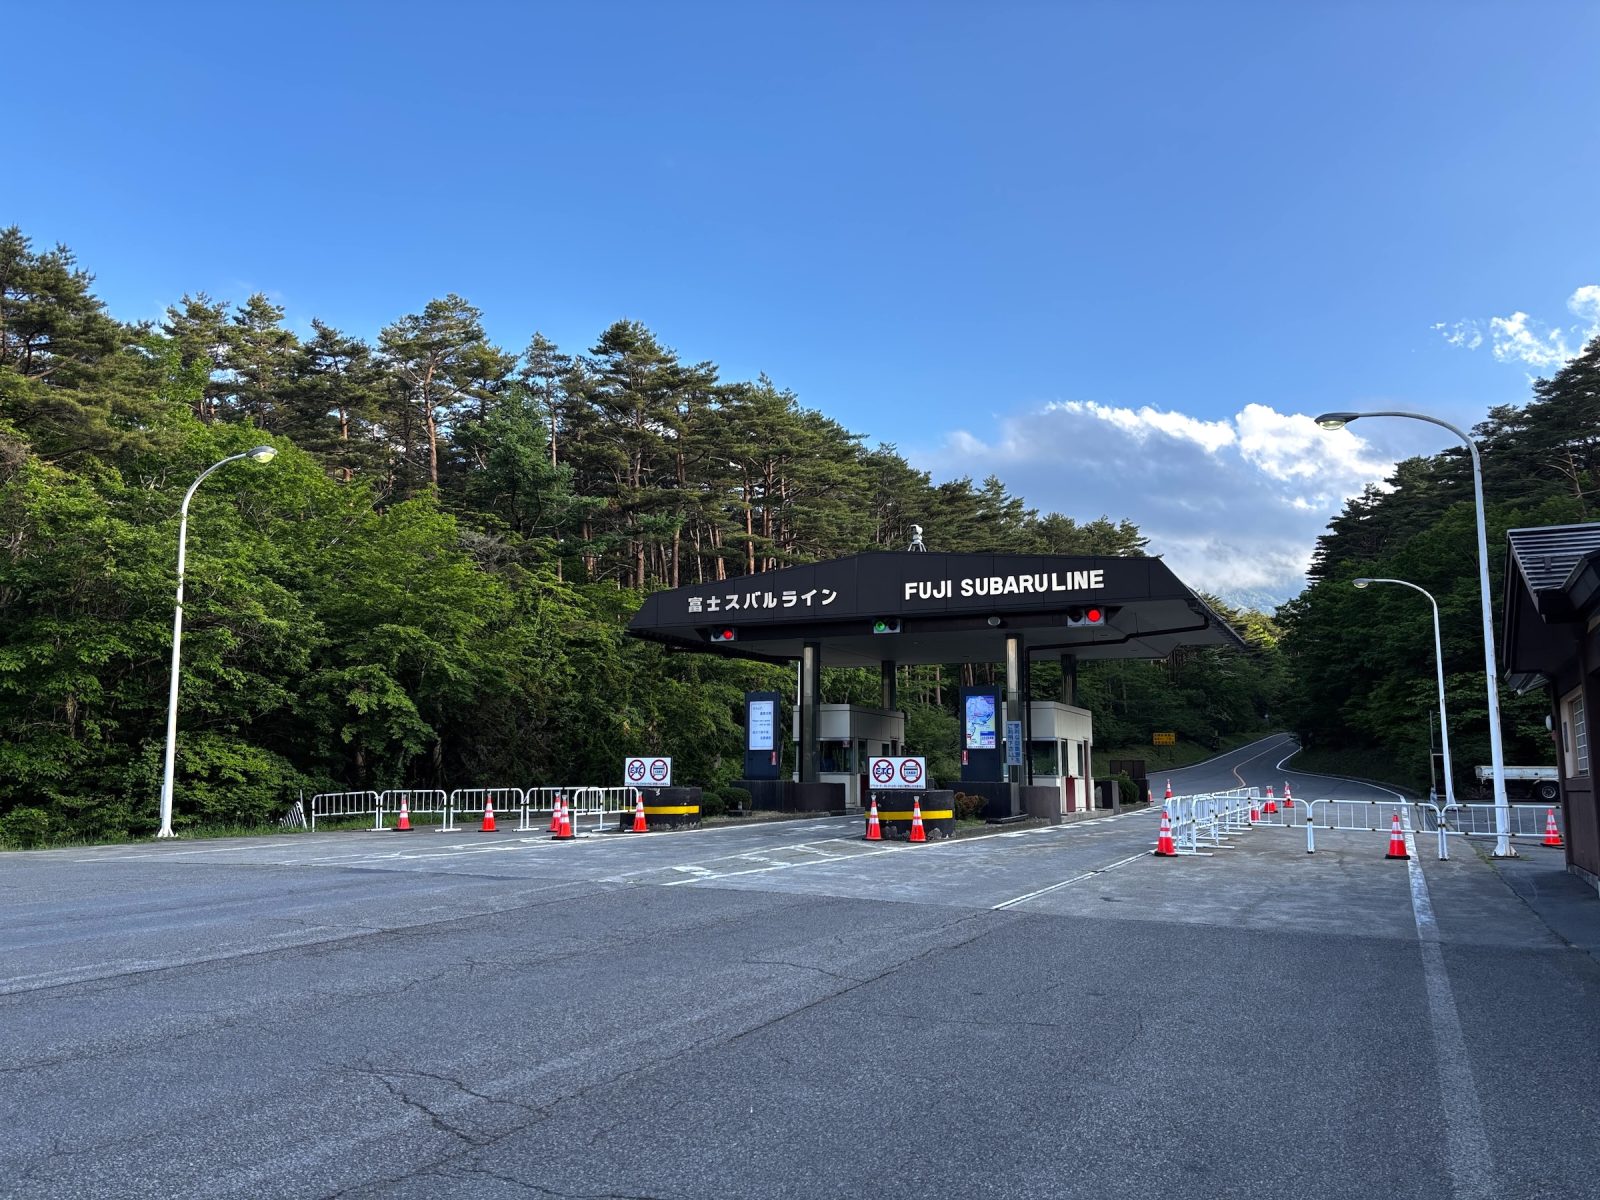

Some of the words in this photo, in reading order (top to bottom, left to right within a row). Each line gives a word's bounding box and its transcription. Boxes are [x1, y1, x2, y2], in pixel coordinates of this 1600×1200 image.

[904, 580, 952, 600] FUJI
[687, 588, 838, 613] 富士スバルライン
[875, 767, 892, 775] ETC
